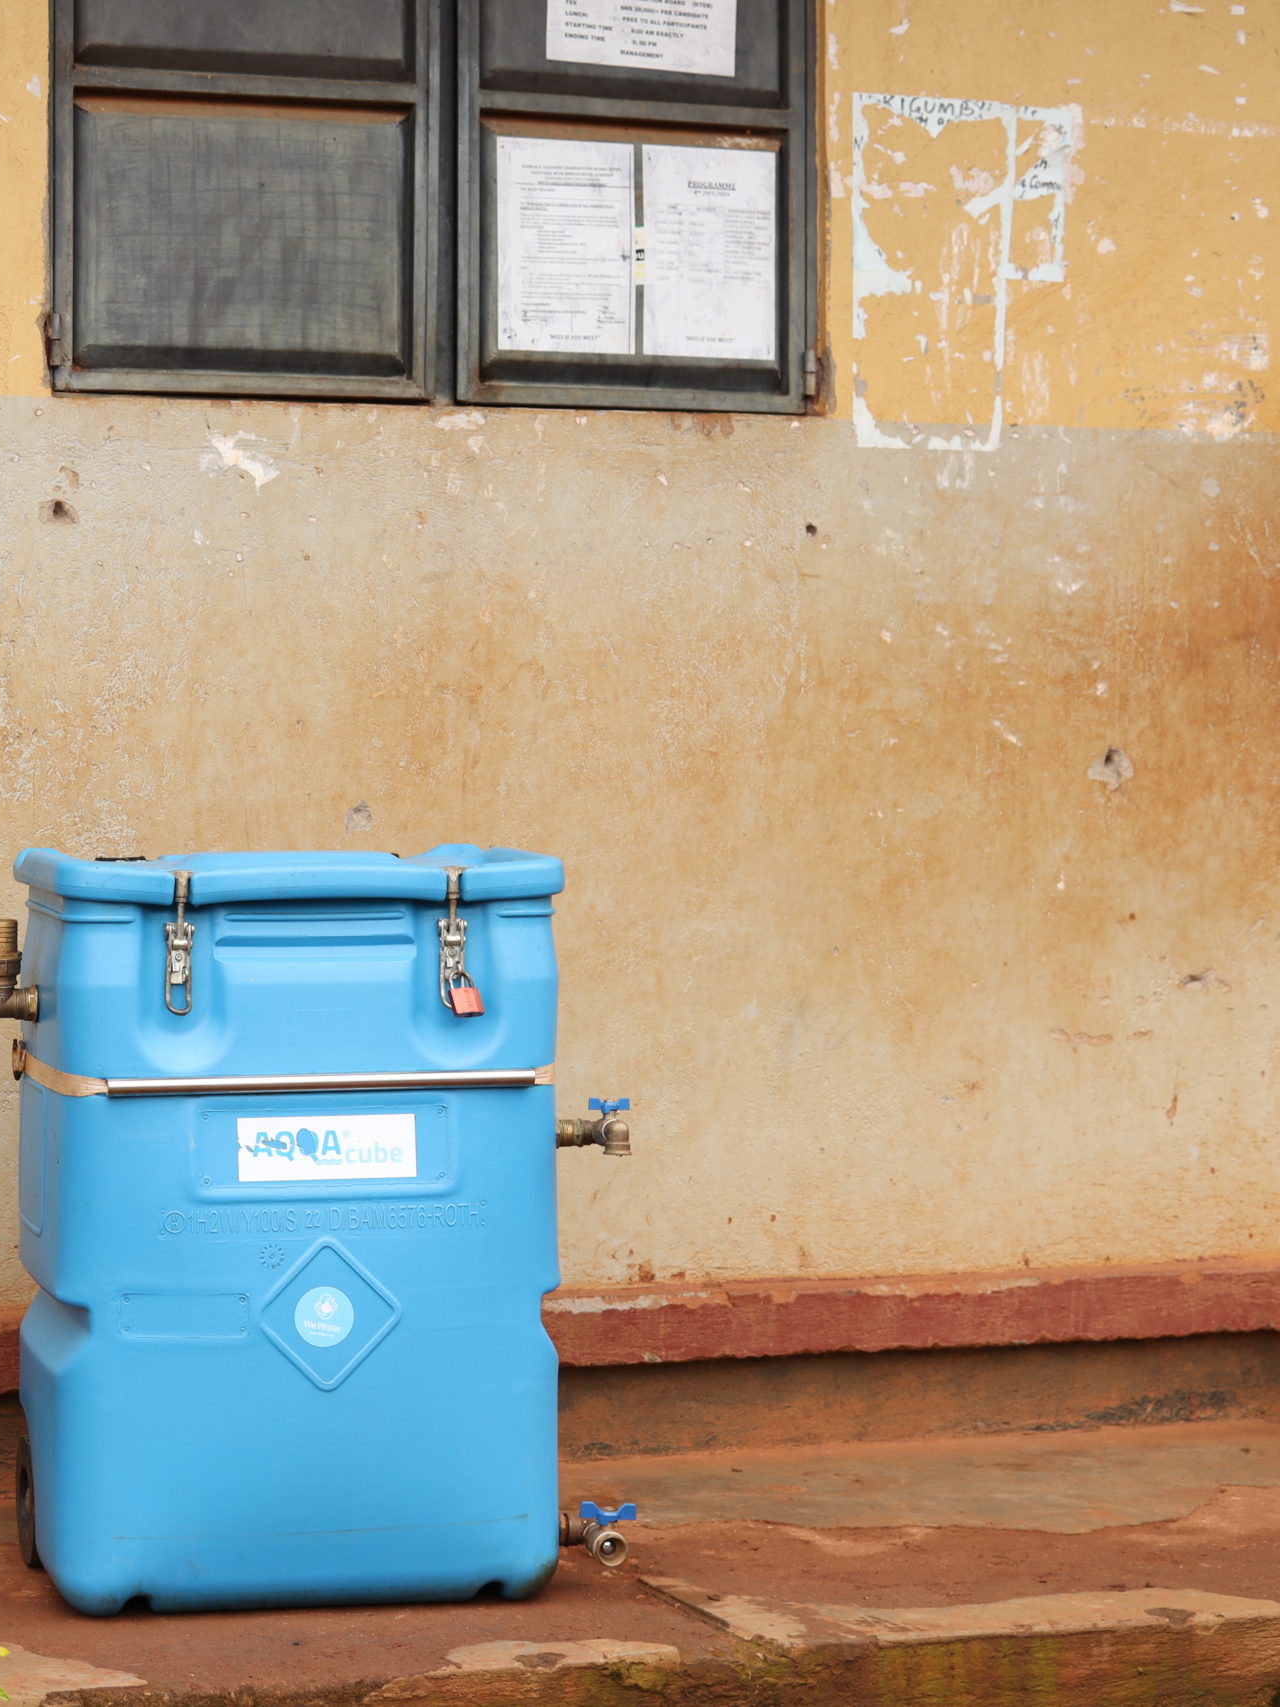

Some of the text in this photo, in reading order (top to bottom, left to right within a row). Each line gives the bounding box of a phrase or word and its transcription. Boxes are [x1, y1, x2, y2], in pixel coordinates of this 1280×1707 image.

[565, 21, 597, 30] STARTING
[564, 32, 589, 40] ENDING
[687, 180, 737, 191] PROGRAMME
[344, 1141, 404, 1164] cube
